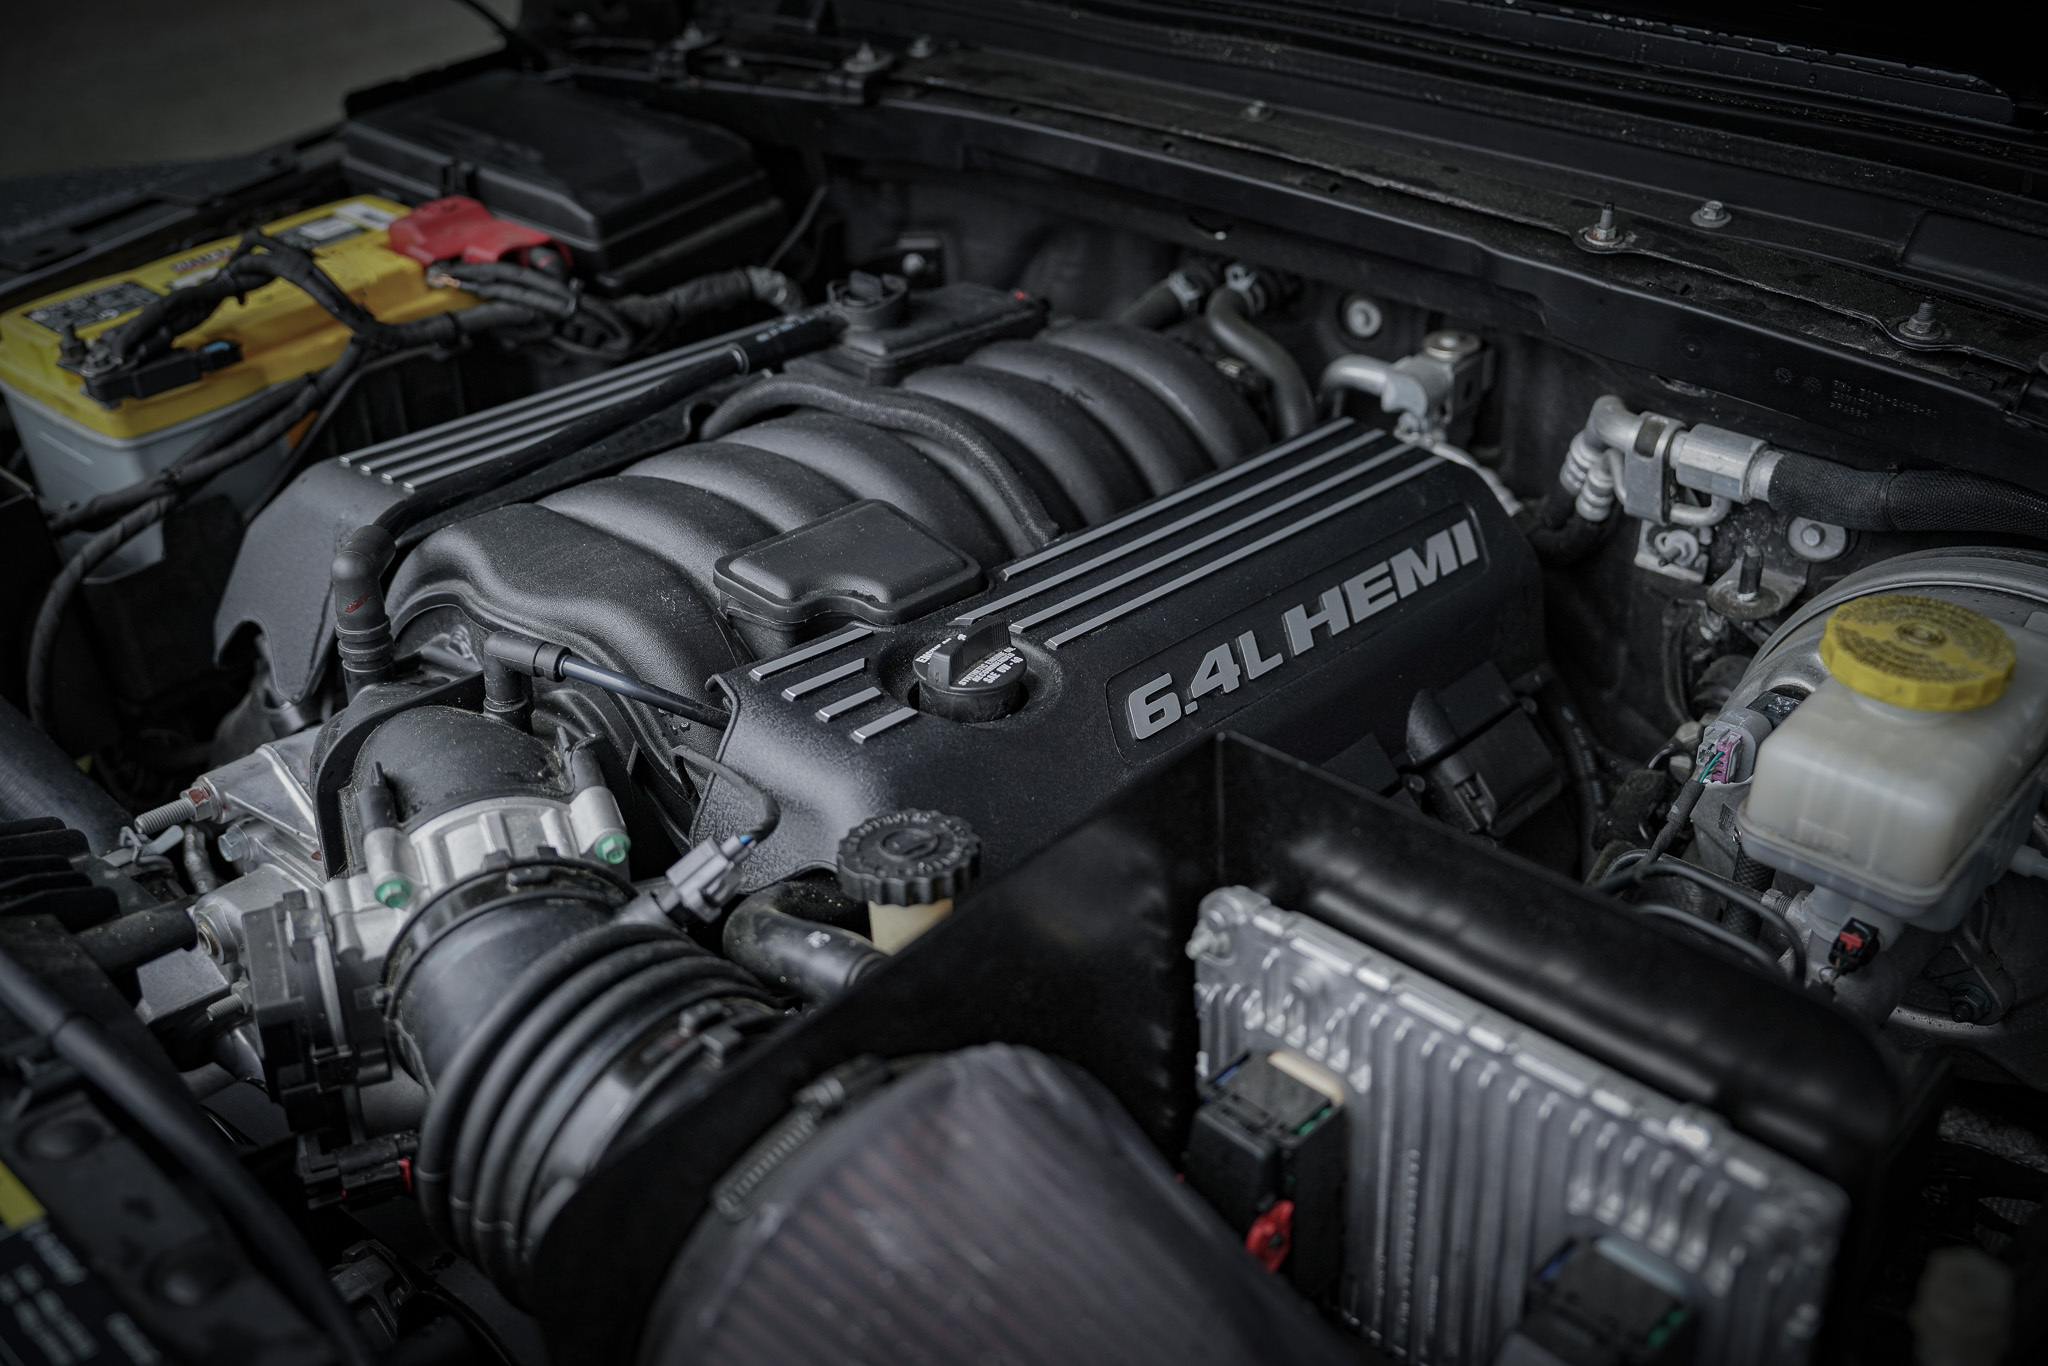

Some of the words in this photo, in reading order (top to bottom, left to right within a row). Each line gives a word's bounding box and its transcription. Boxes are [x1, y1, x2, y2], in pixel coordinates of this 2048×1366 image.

[982, 671, 1001, 684] SAE
[1127, 630, 1284, 741] 6.4L
[1281, 519, 1480, 657] HEMI
